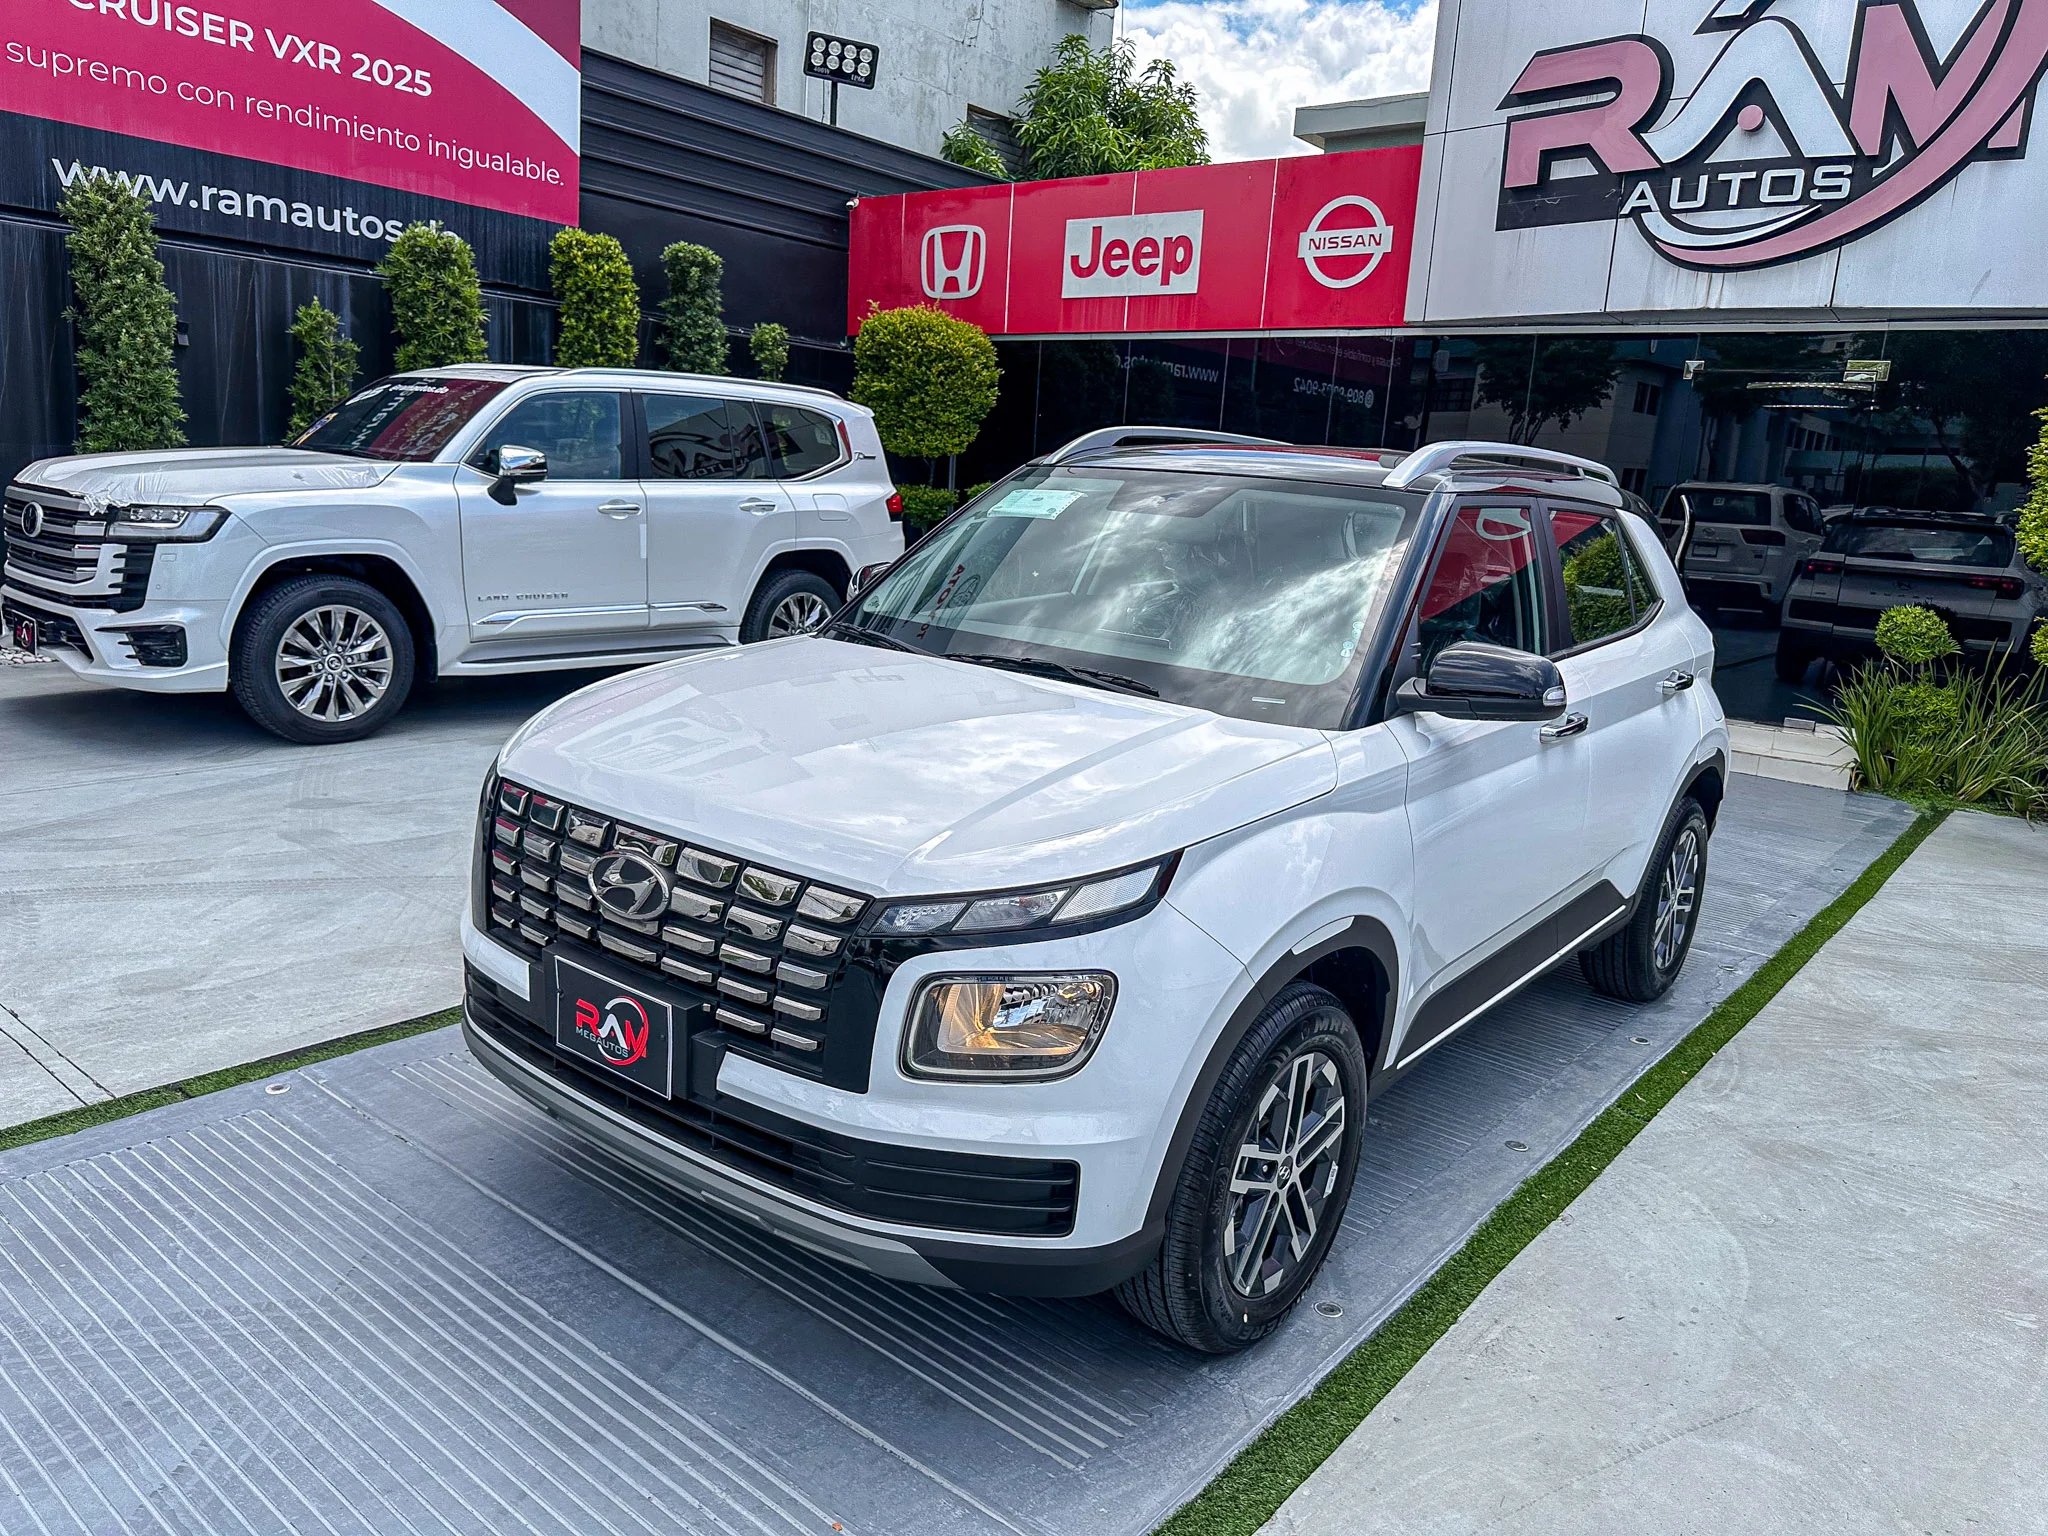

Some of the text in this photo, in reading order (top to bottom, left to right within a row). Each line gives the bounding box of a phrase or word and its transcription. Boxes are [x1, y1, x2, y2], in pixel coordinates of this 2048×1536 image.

[68, 0, 433, 98] RUISER VXR 2025
[6, 41, 565, 187] supremo con rendimiento inigualable.
[1620, 163, 1854, 216] AUTOS
[1070, 225, 1194, 286] Jeep
[1308, 232, 1383, 251] NISSAN
[478, 592, 569, 602] LAND CRUISER
[575, 1026, 629, 1058] MEGAUTOS
[576, 998, 647, 1059] RAM
